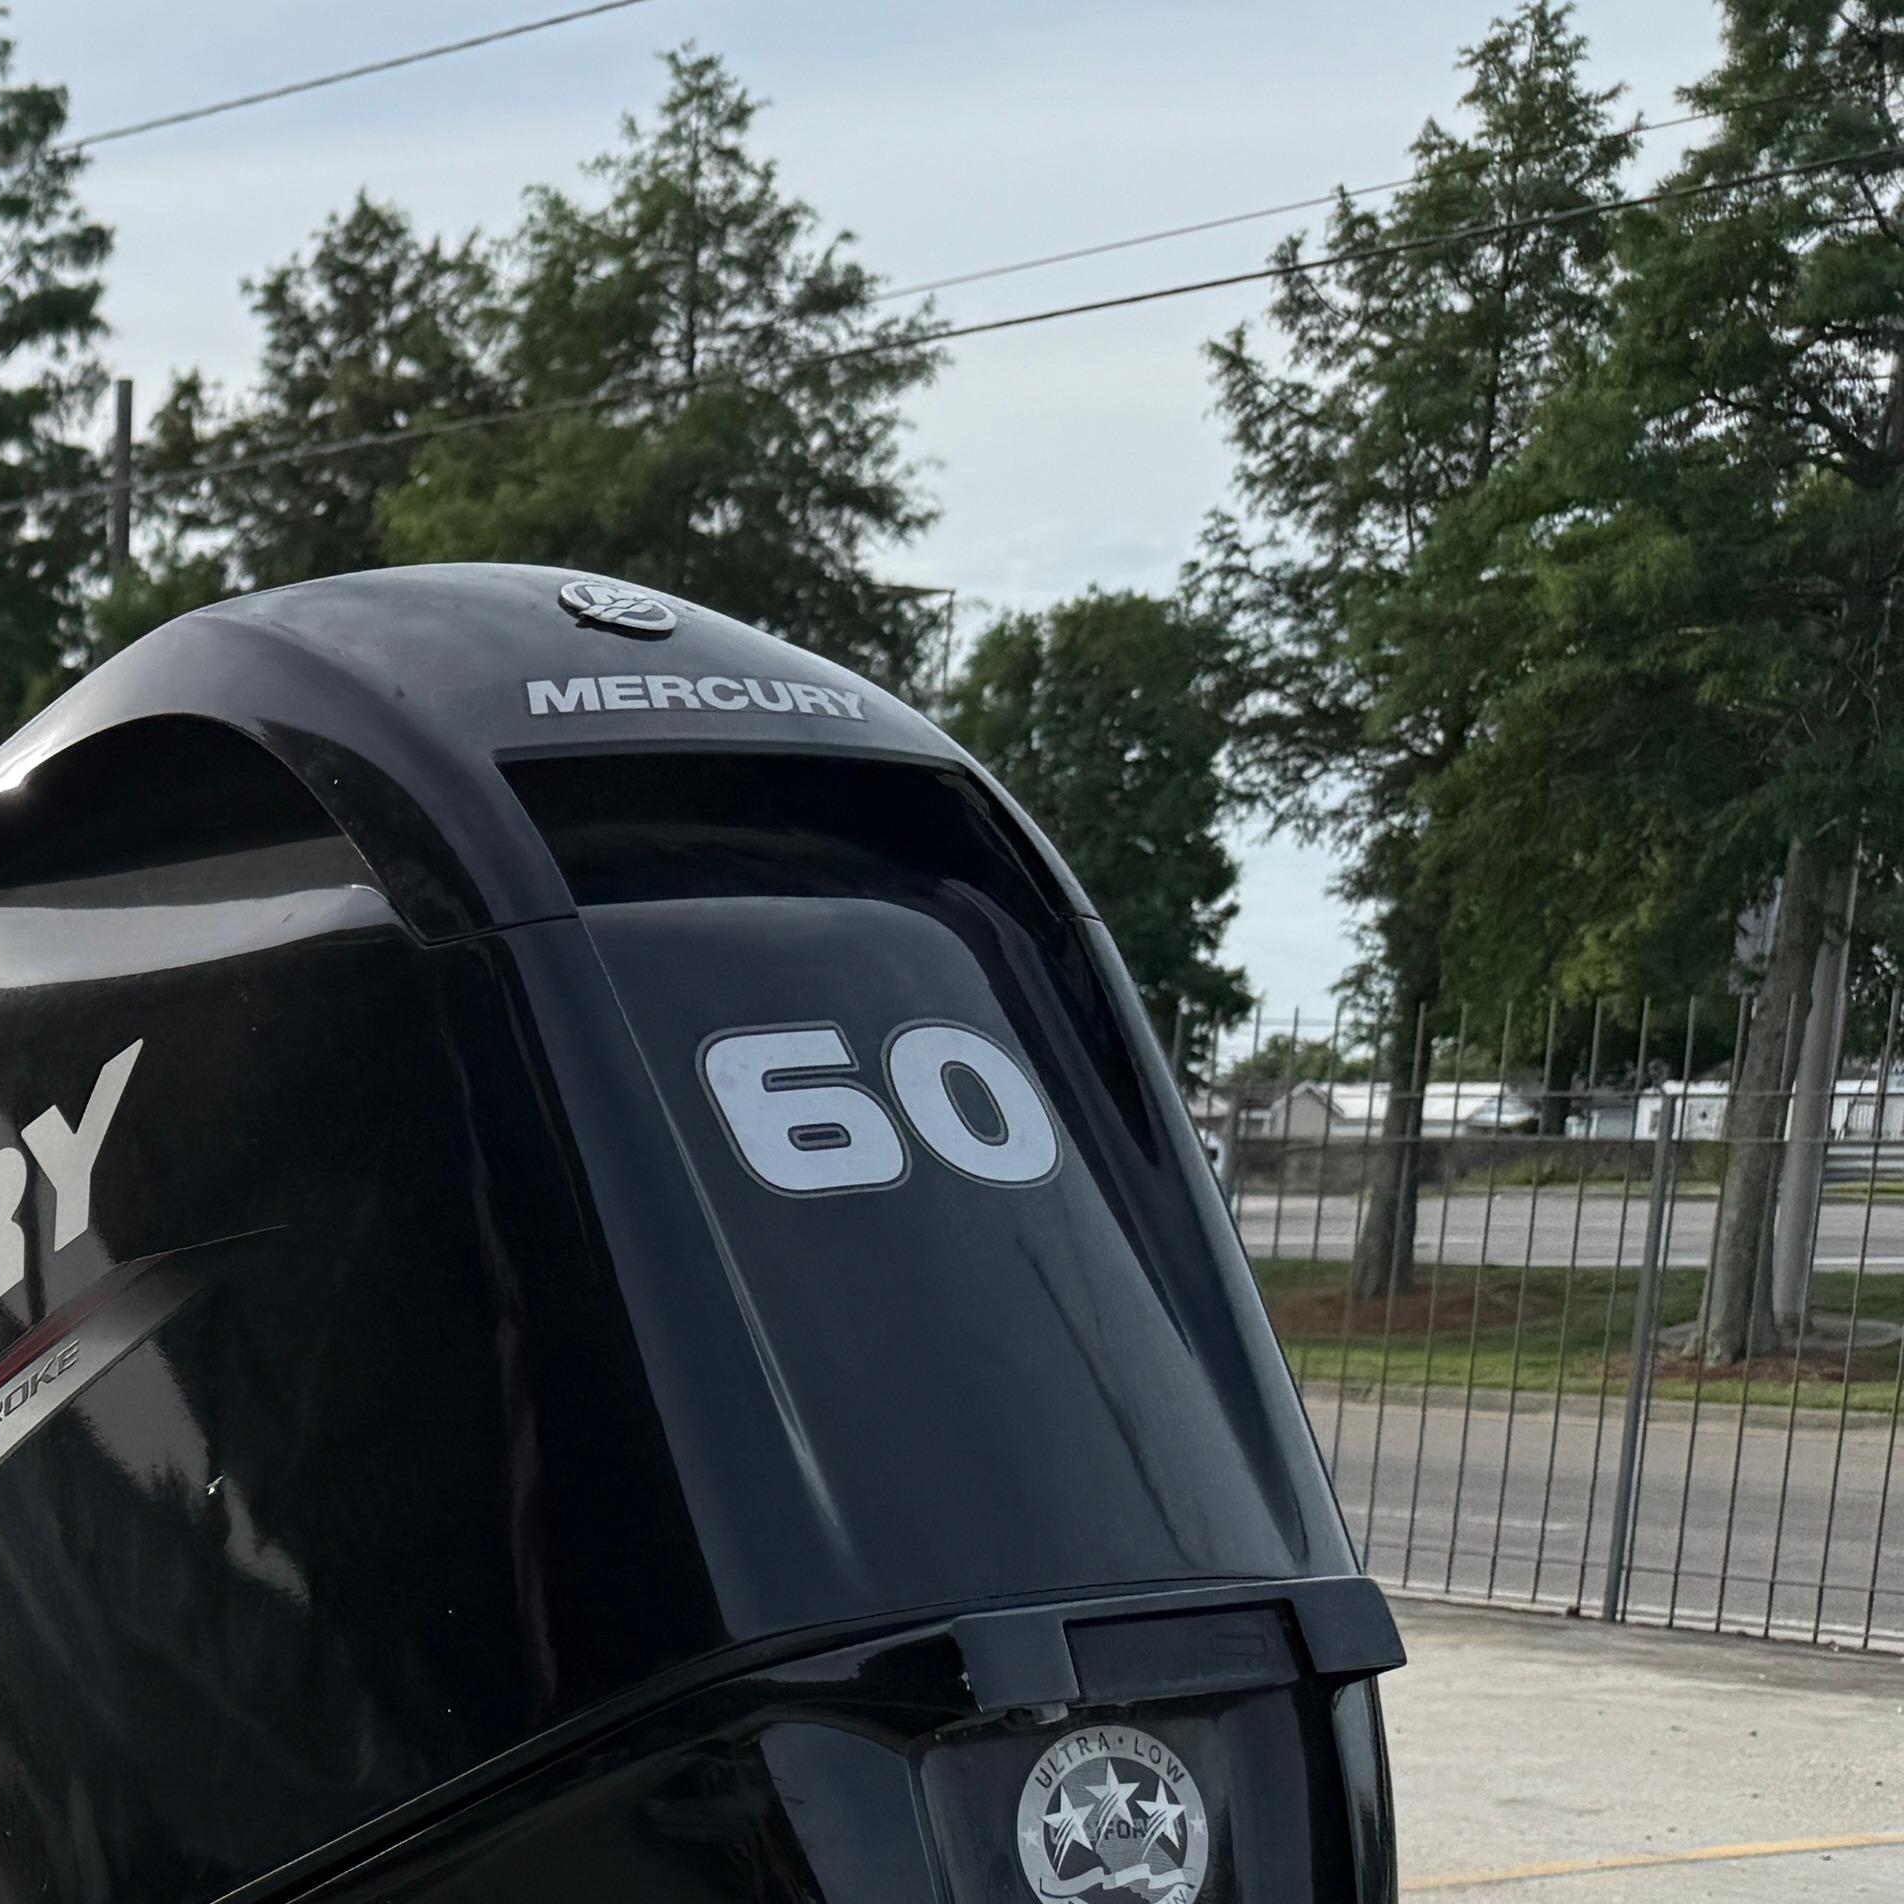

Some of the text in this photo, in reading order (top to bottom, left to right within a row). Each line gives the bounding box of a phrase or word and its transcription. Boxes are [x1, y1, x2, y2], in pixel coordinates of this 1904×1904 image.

[526, 676, 866, 721] MERCURY
[696, 1018, 1063, 1198] 60
[1035, 1731, 1185, 1789] ULTRA LOW
